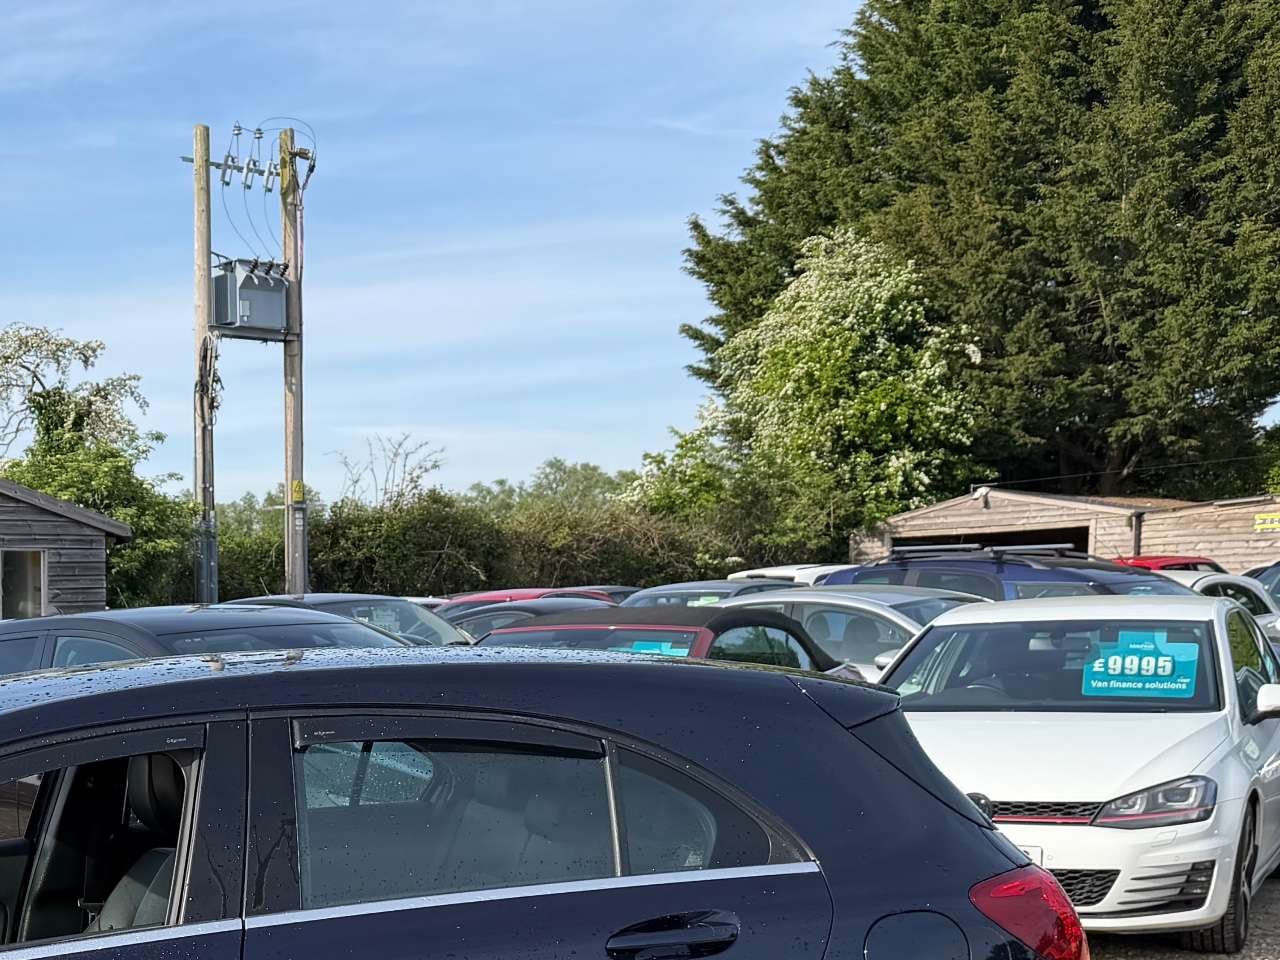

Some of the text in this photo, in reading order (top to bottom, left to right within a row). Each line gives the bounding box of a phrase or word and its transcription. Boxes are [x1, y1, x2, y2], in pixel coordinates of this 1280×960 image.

[1090, 679, 1188, 690] Van finance solutions
